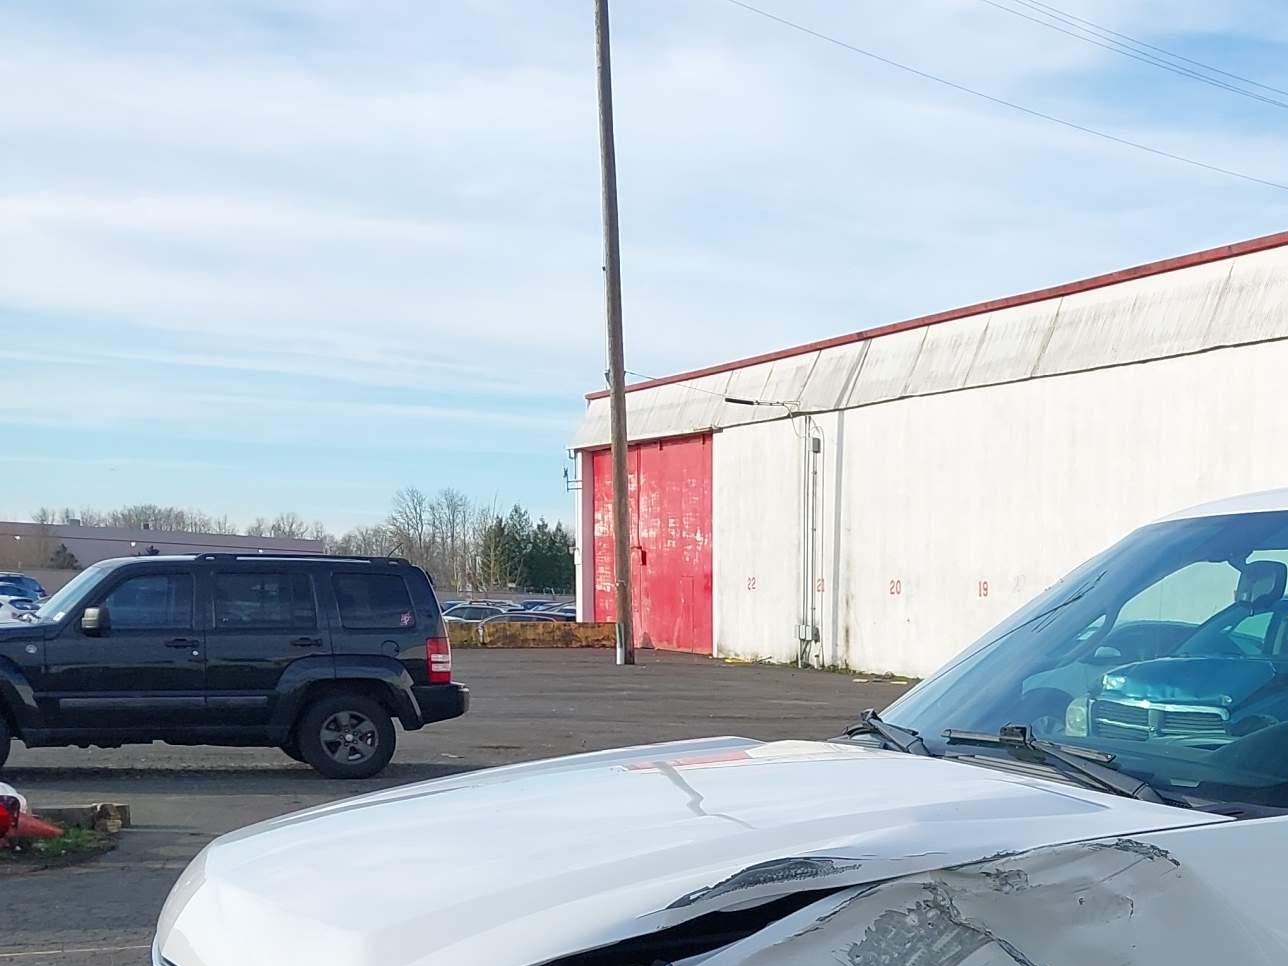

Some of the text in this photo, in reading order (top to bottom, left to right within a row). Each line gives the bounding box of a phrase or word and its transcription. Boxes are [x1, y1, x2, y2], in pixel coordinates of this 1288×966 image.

[747, 576, 757, 591] 22
[889, 579, 901, 595] 20
[978, 581, 989, 597] 19
